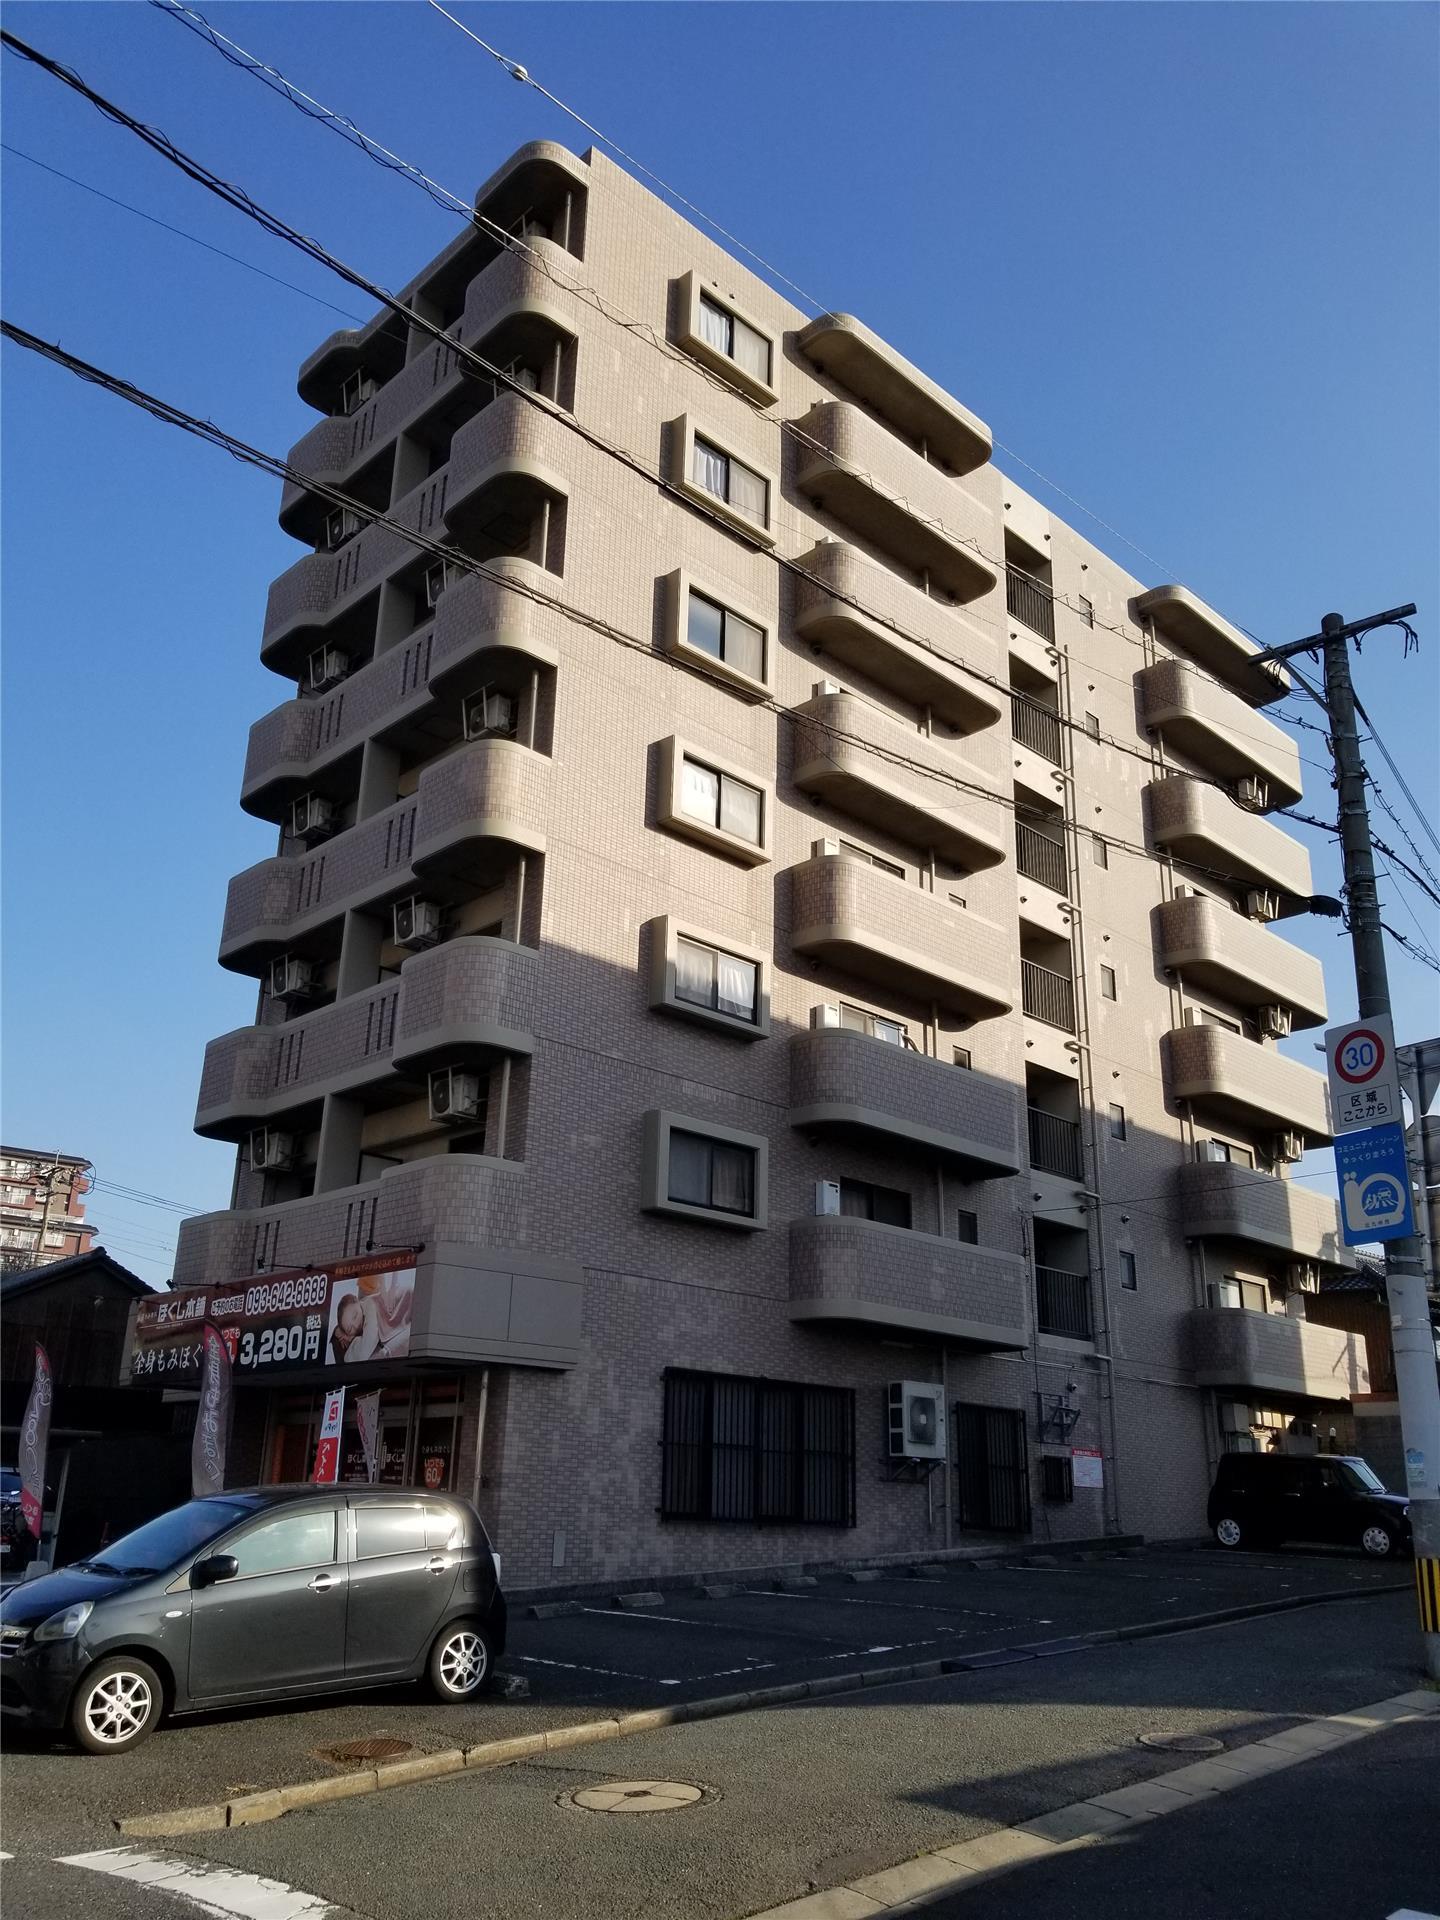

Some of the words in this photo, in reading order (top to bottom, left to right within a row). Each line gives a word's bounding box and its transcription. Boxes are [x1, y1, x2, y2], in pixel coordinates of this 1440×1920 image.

[1345, 1043, 1373, 1070] 30
[1351, 1090, 1377, 1107] 区域
[1344, 1102, 1388, 1121] ここから
[245, 1274, 328, 1316] 093-642-8688
[306, 1315, 322, 1330] 税込
